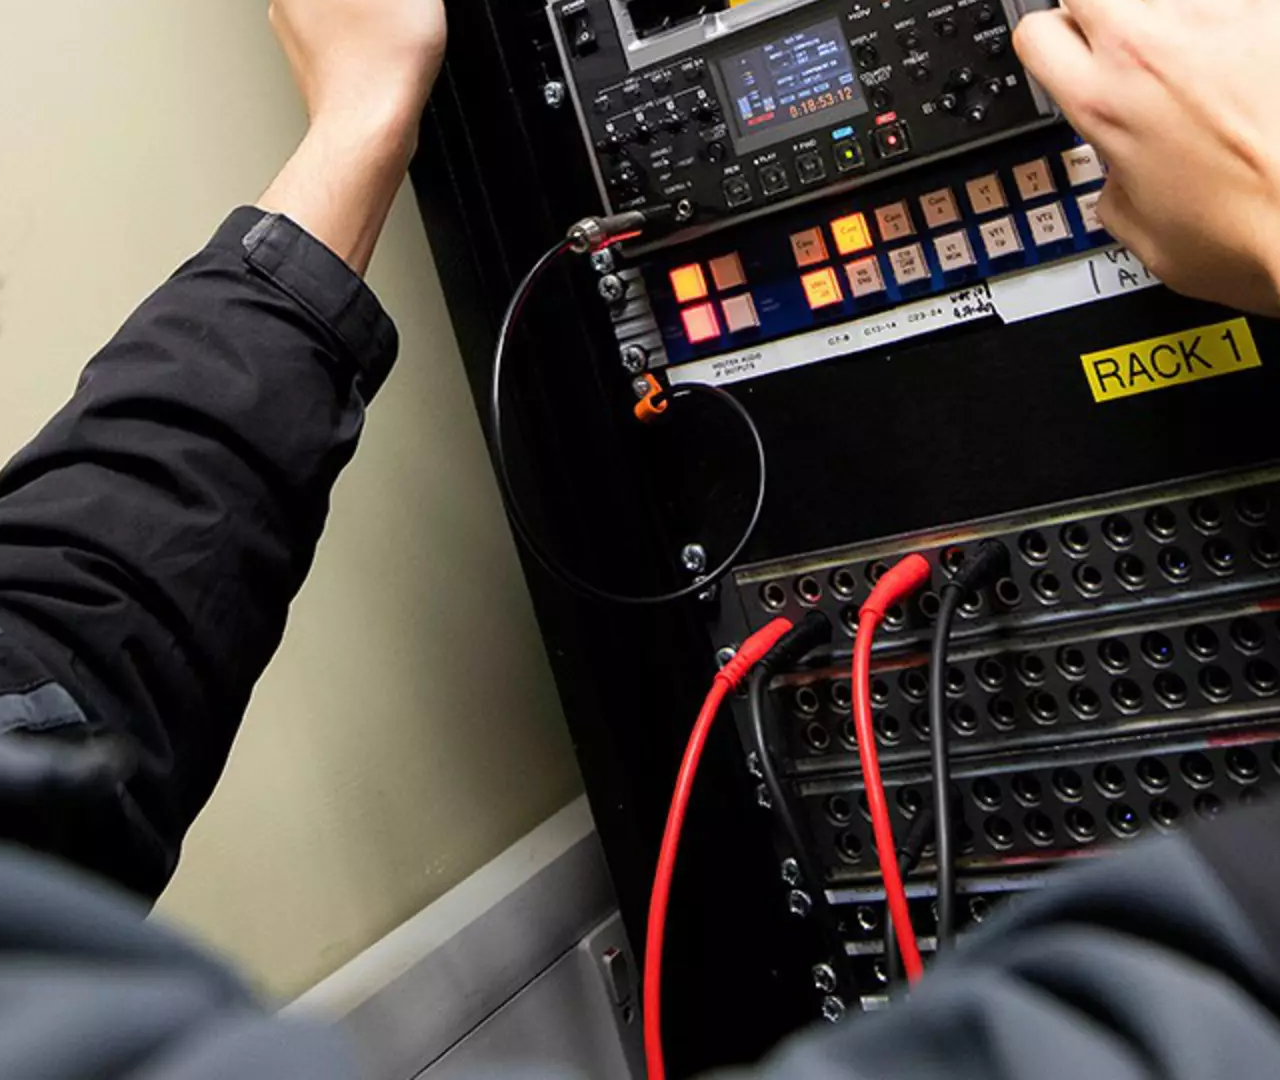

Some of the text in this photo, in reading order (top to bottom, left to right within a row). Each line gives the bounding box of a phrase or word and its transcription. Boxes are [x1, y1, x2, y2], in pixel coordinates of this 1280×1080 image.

[789, 86, 853, 119] 0:18:53:12
[1093, 329, 1243, 393] RACK 1
